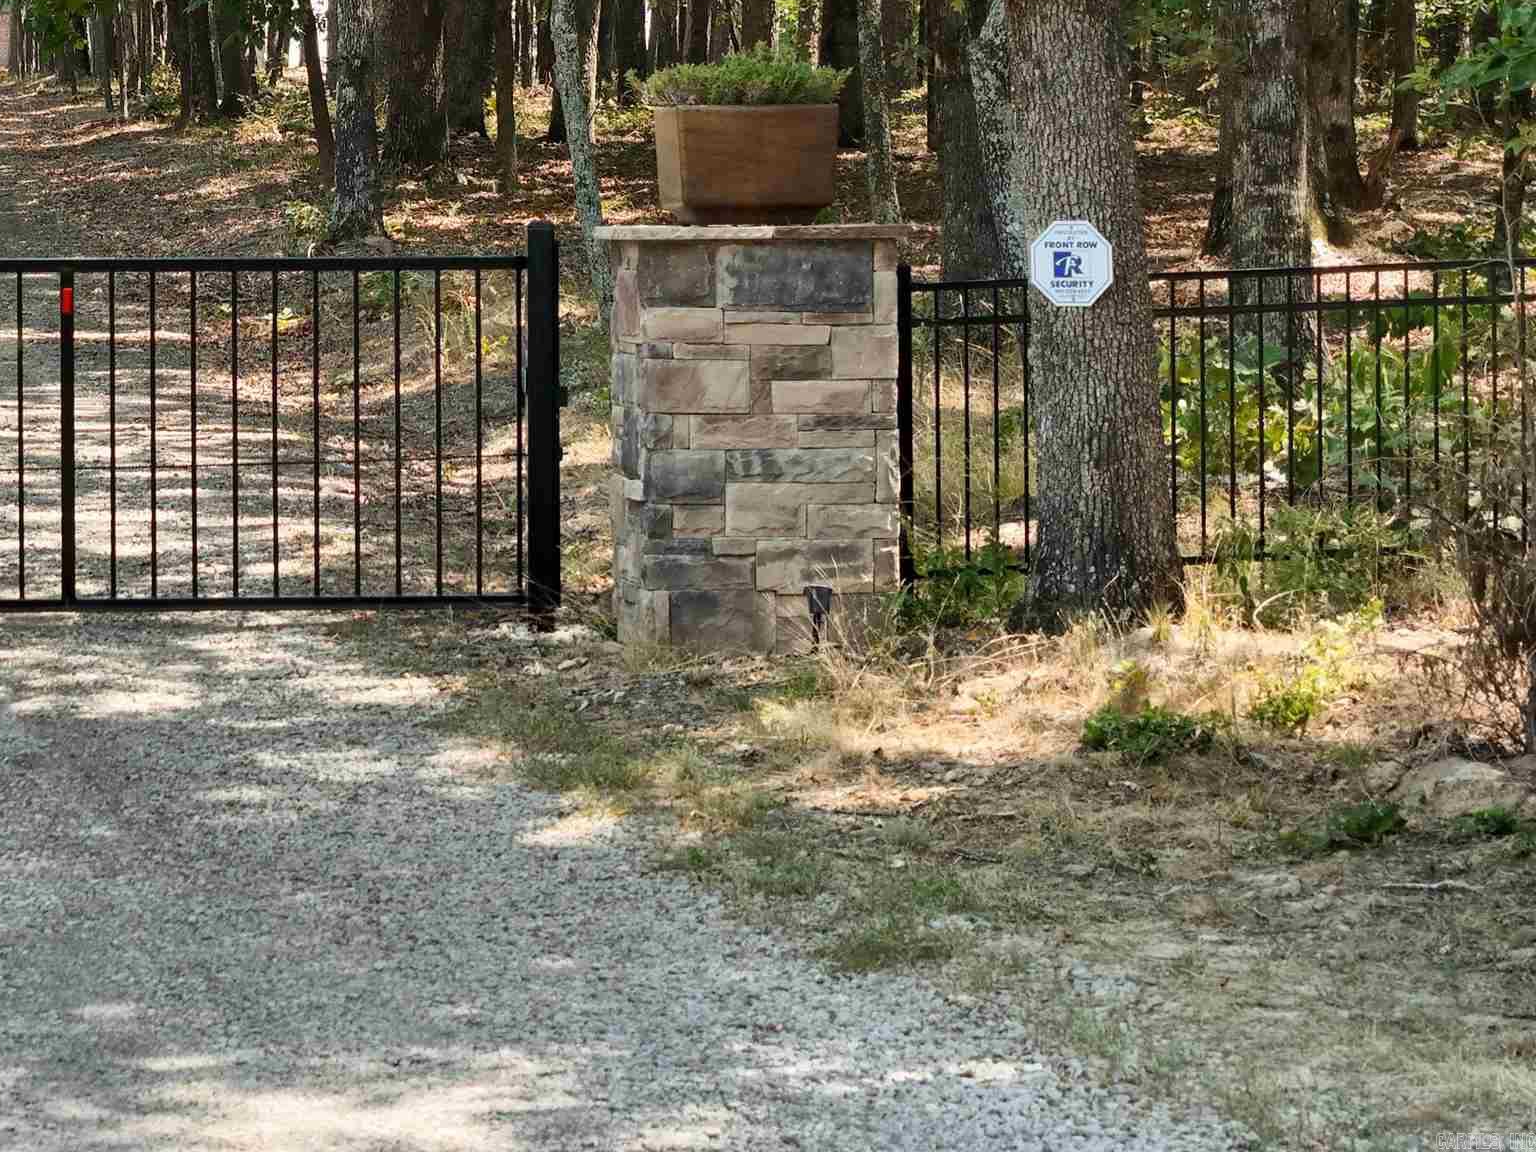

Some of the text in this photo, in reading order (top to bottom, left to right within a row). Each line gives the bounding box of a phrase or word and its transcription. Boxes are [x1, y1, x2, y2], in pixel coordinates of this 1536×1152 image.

[1044, 241, 1098, 249] FRONT ROW
[1050, 280, 1094, 288] SECURITY
